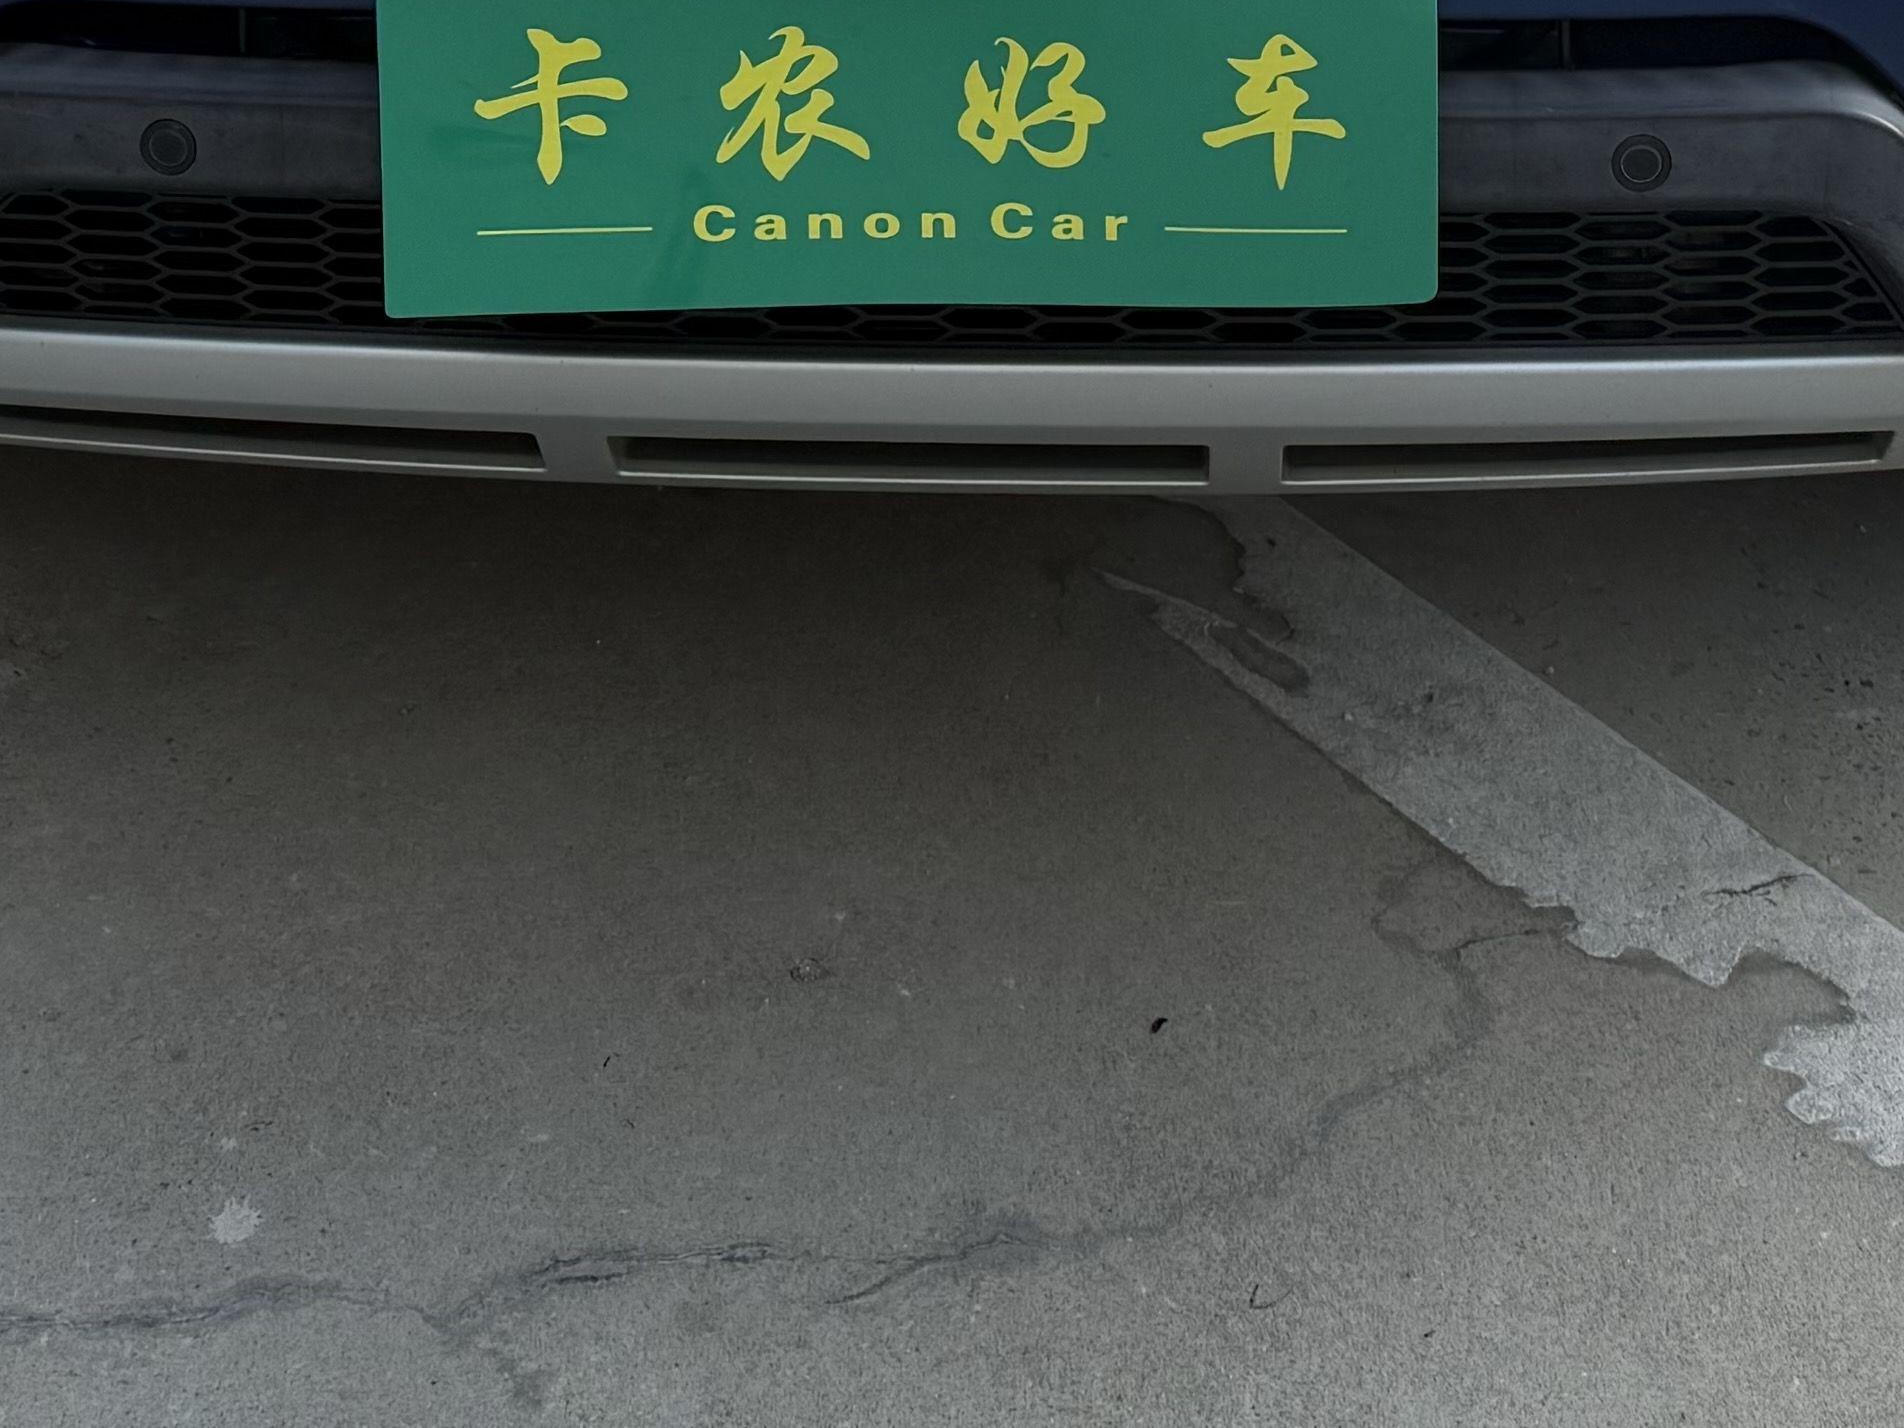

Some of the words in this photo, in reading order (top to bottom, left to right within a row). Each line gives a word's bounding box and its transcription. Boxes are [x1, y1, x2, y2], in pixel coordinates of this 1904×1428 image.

[473, 26, 1347, 190] 卡农好车
[693, 204, 958, 242] Canon
[989, 202, 1129, 241] Car
